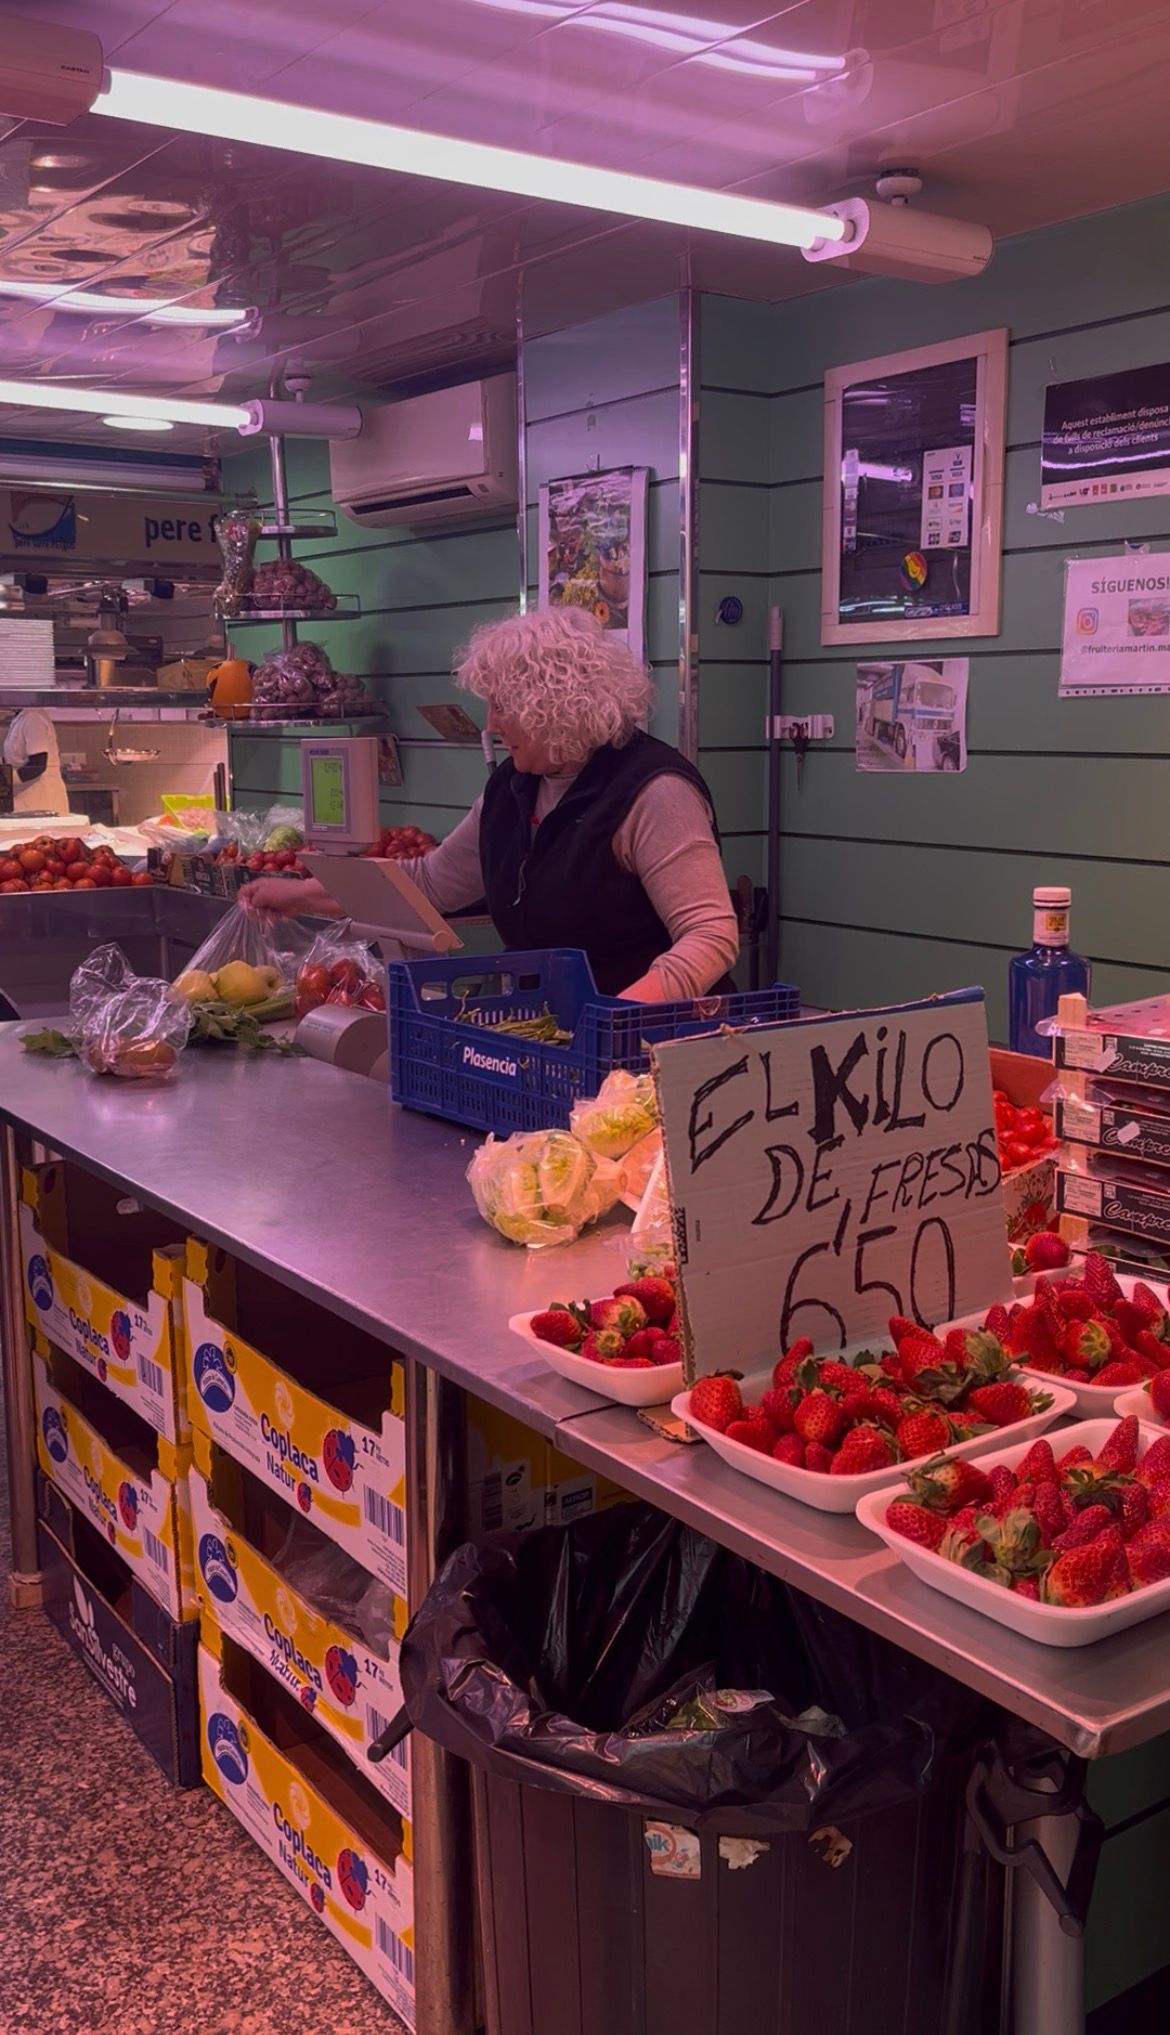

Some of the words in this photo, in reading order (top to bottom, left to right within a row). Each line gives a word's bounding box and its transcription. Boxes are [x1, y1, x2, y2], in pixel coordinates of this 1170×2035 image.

[1061, 418, 1088, 431] Aquest
[1090, 410, 1136, 425] establiment
[1137, 405, 1169, 418] disposa
[1082, 430, 1091, 440] de
[1074, 438, 1112, 455] disposició
[1132, 433, 1159, 445] clients
[145, 516, 206, 547] pere
[1091, 576, 1170, 594] SÍGUENOS!
[463, 1046, 517, 1077] Plasencia
[688, 1051, 799, 1176] EL
[751, 1134, 846, 1226] DE
[859, 1128, 1002, 1224] FRESAS
[69, 1306, 110, 1356] Coplaca
[261, 1413, 320, 1483] Coplaca
[361, 1436, 376, 1456] 17
[267, 1451, 296, 1492] Natur
[84, 1465, 118, 1522] Coplaca
[264, 1613, 323, 1692] Coplaca
[364, 1658, 378, 1678] 17
[273, 1803, 332, 1890] Coplaca
[279, 1839, 310, 1887] Natur
[374, 1868, 388, 1890] 17
